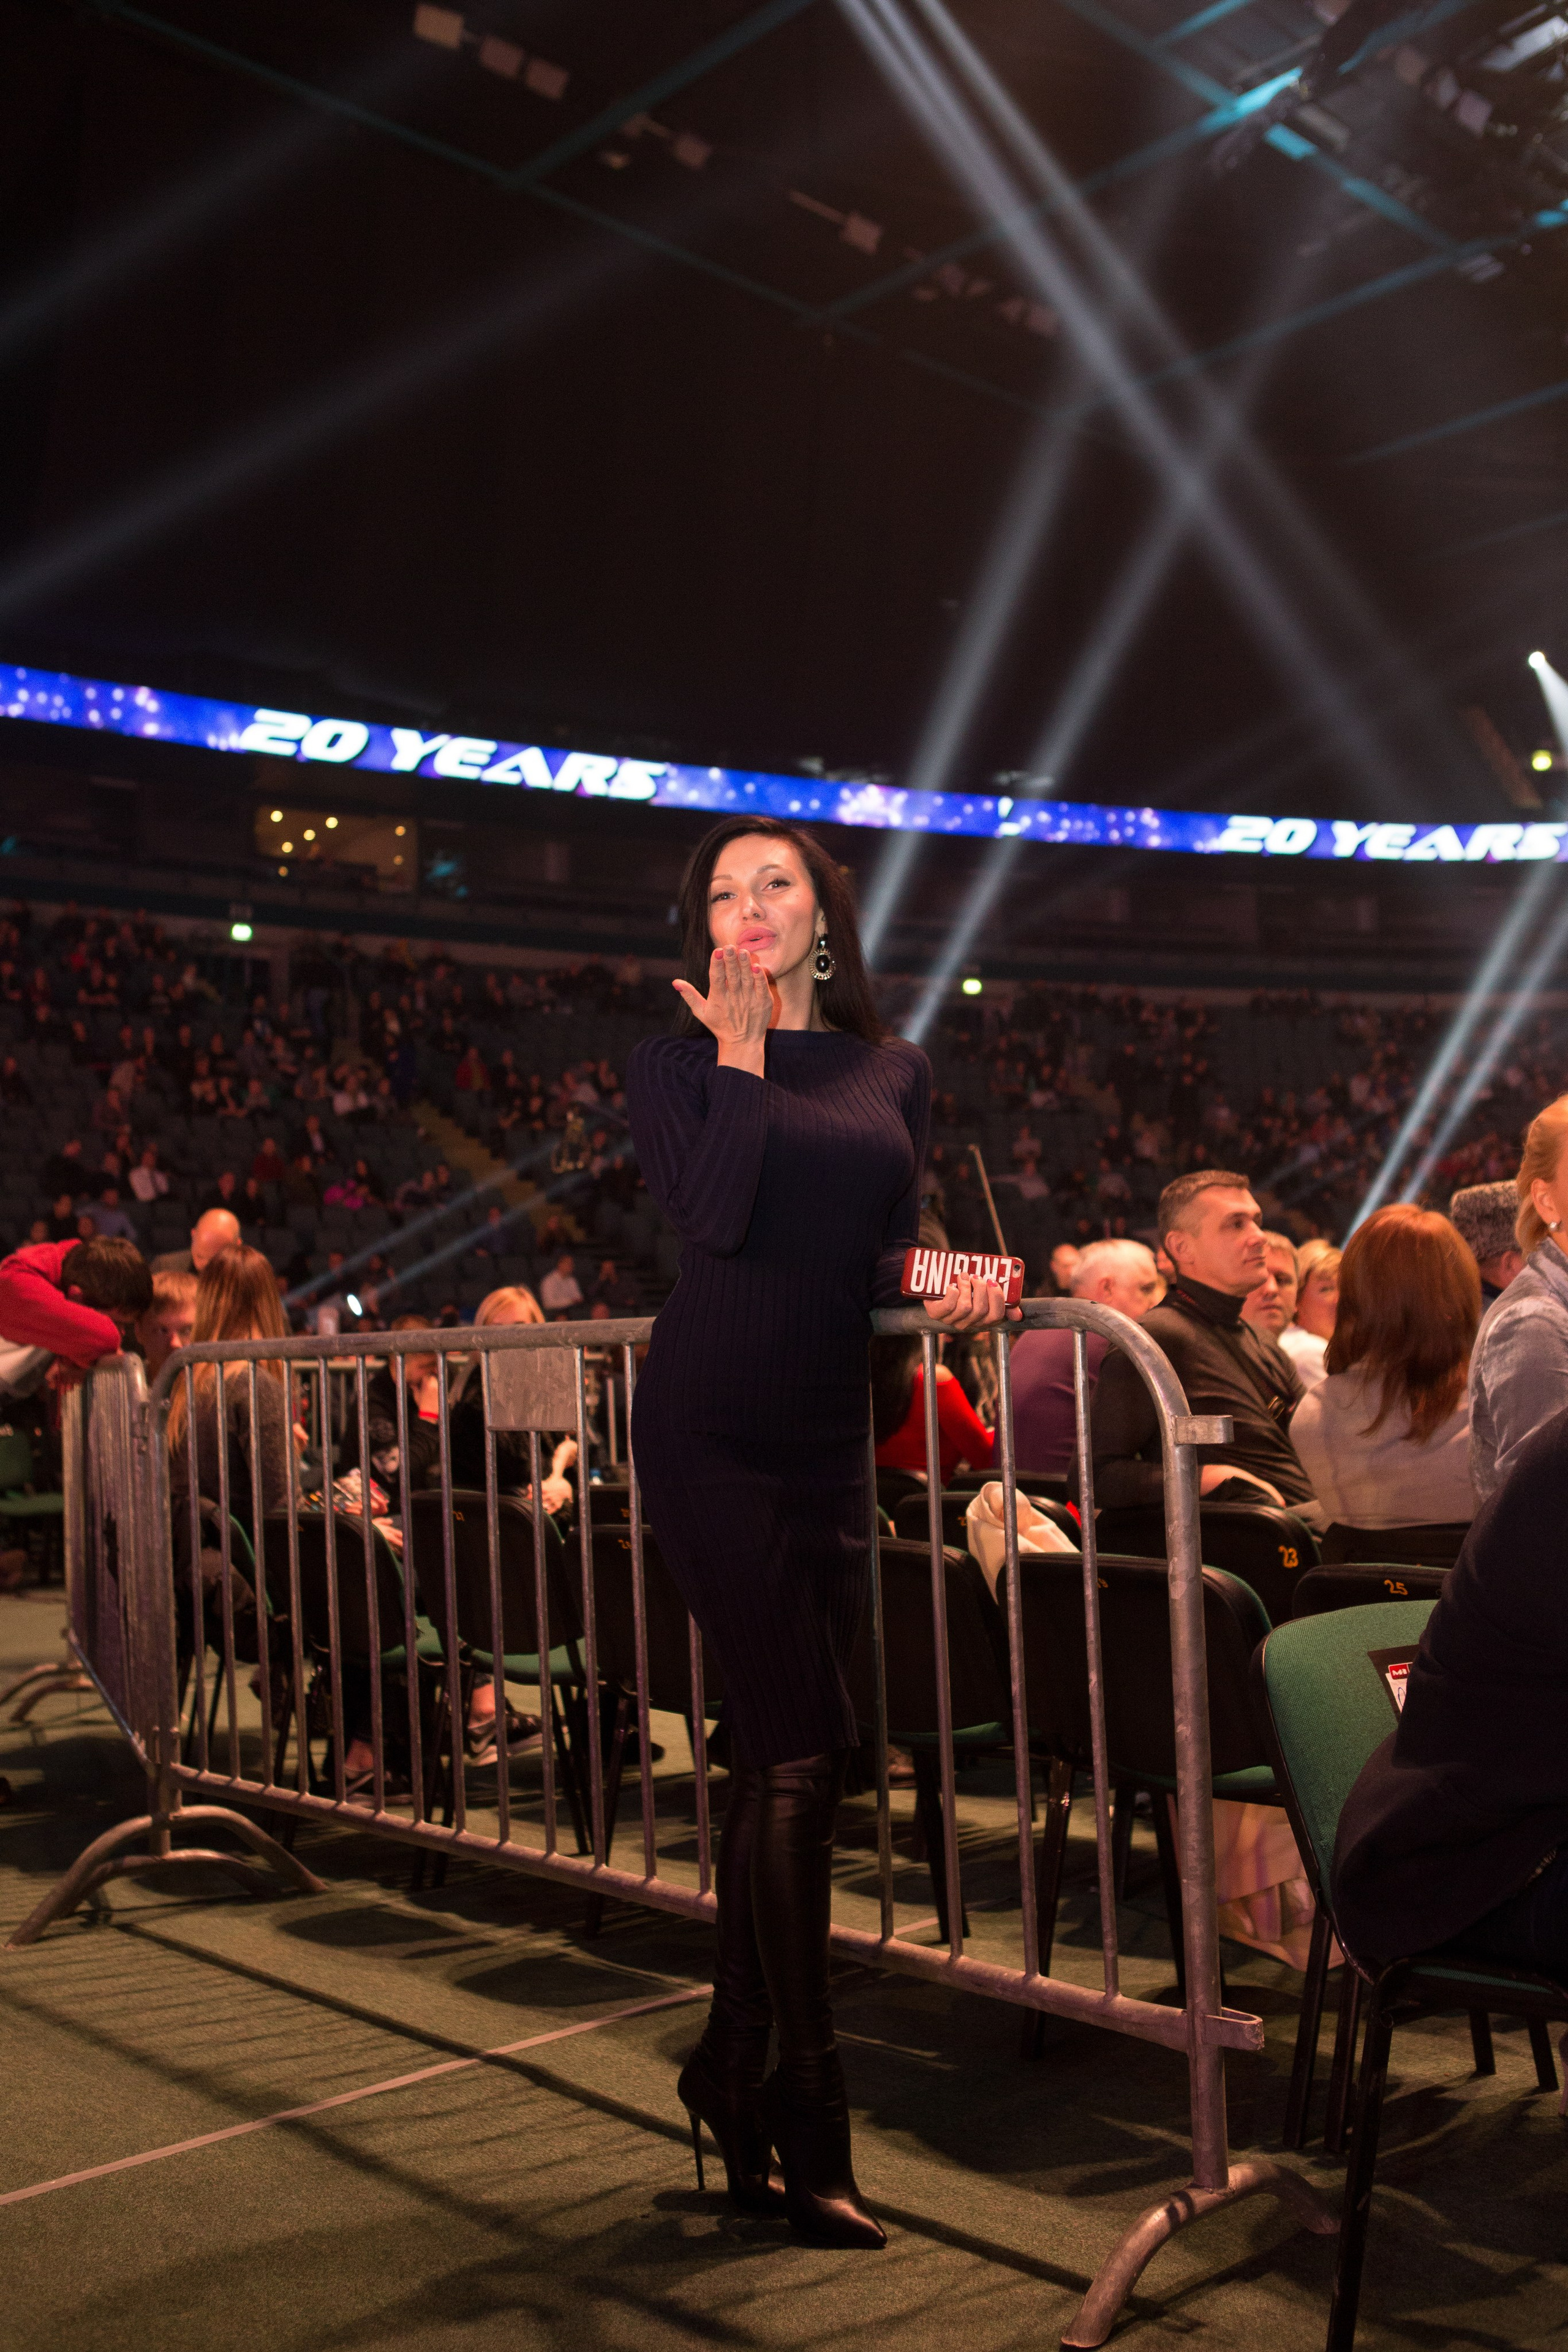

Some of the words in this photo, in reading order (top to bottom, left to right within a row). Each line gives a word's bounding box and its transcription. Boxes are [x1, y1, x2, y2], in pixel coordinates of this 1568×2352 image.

[241, 709, 369, 763] 20
[390, 728, 666, 799] YEARS
[1219, 815, 1317, 854] 20
[1332, 821, 1568, 861] YEARS
[1278, 1545, 1298, 1568] 23
[1384, 1579, 1409, 1595] 25
